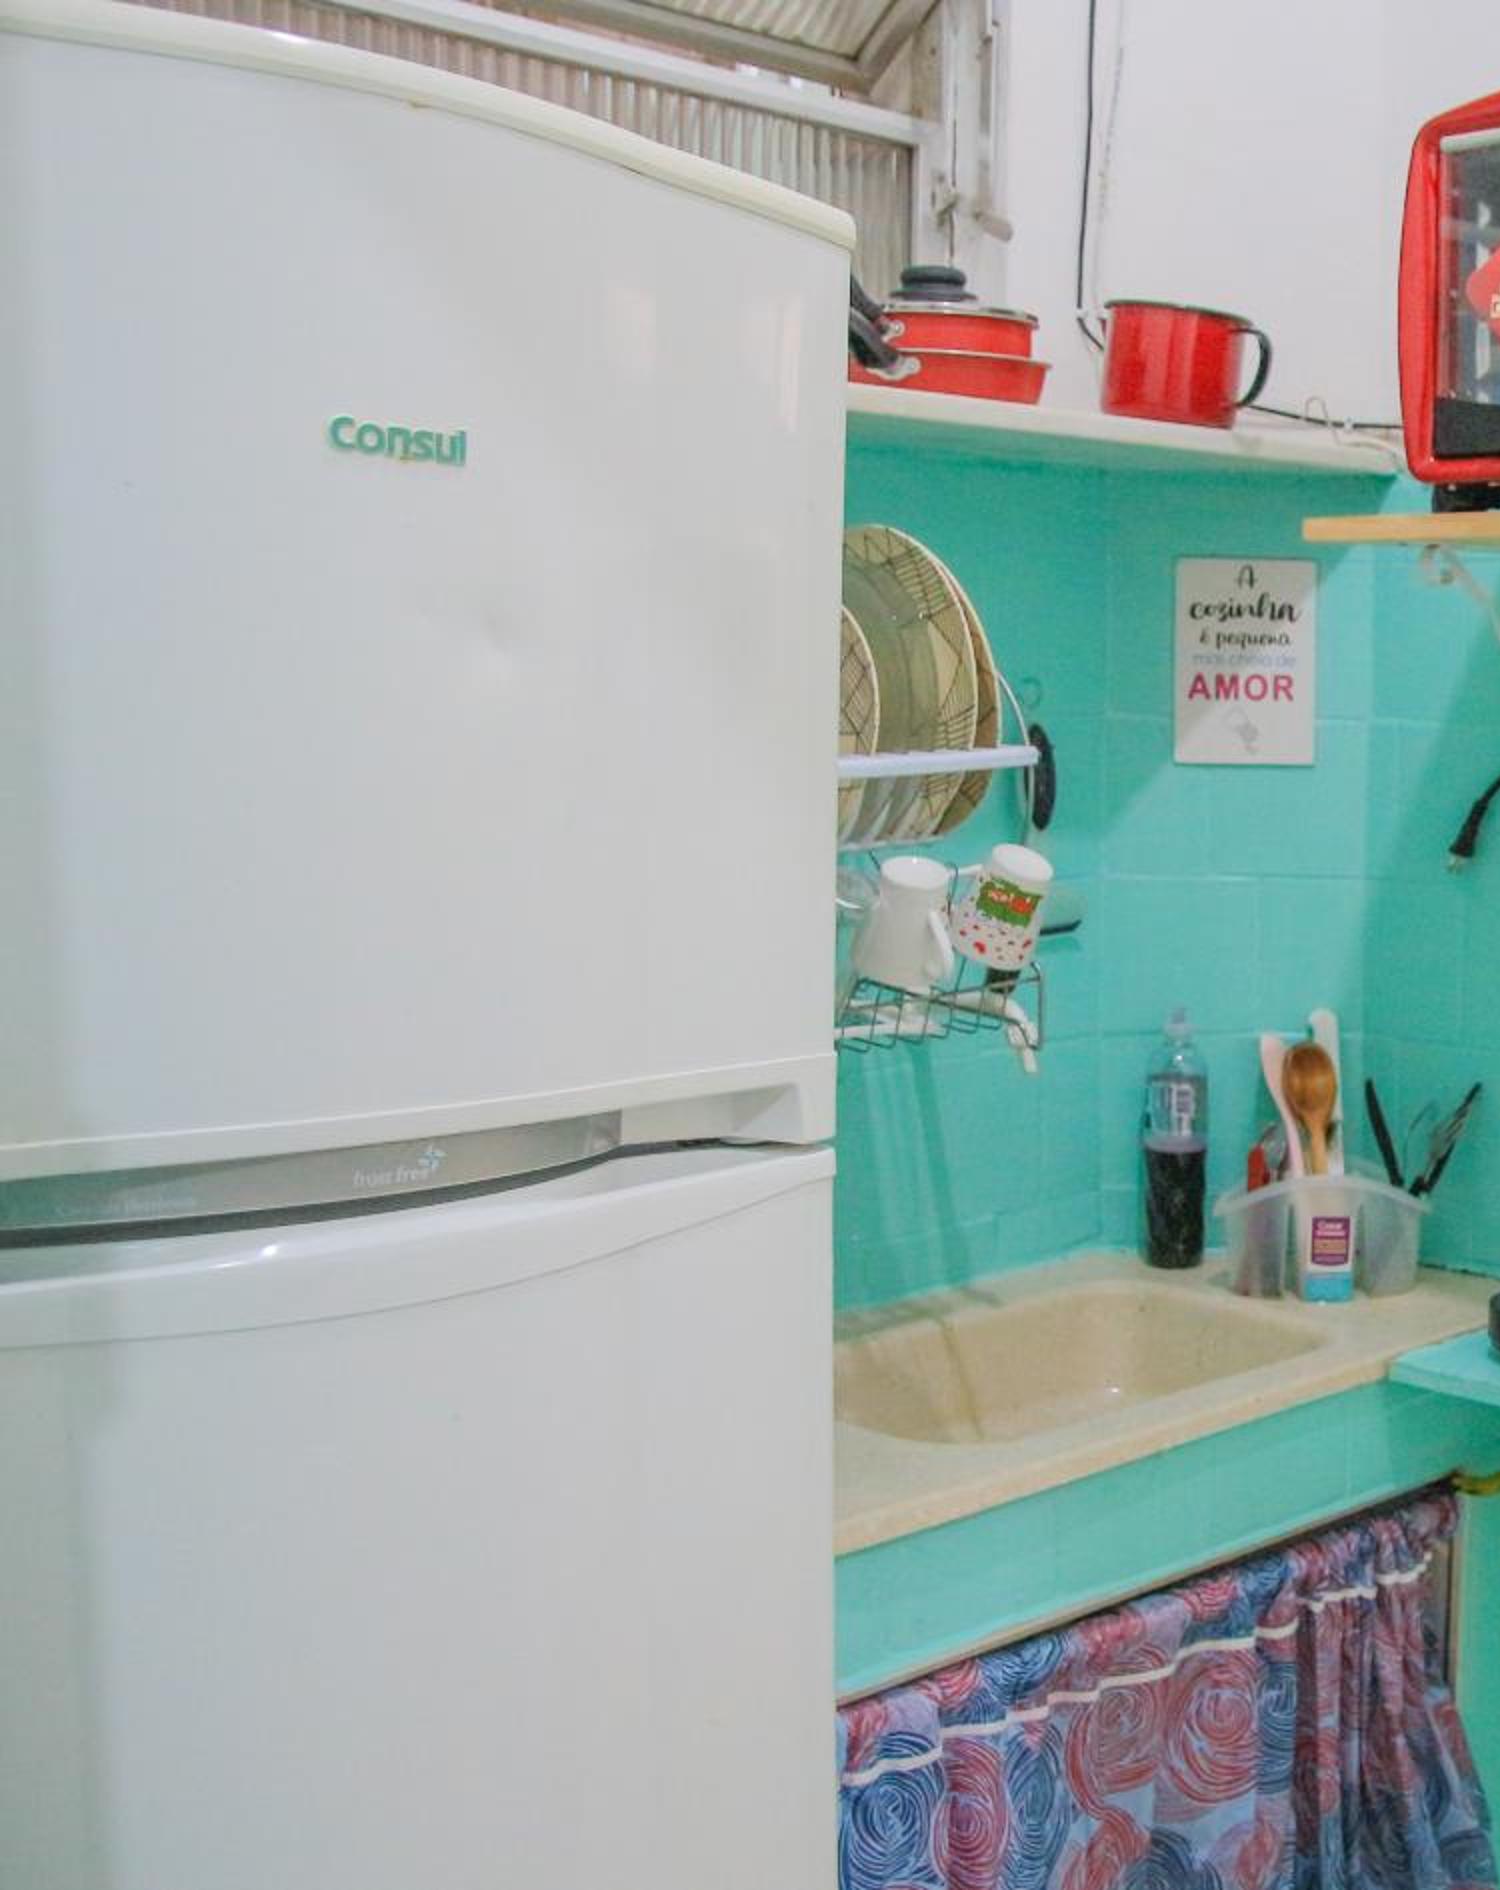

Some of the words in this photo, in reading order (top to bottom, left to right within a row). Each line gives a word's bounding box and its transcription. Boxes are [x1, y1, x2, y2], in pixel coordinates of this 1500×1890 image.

[329, 416, 467, 467] Consul
[1236, 563, 1259, 589] A
[1189, 592, 1303, 623] cozinha
[1214, 630, 1292, 650] pequena
[1187, 671, 1295, 701] AMOR
